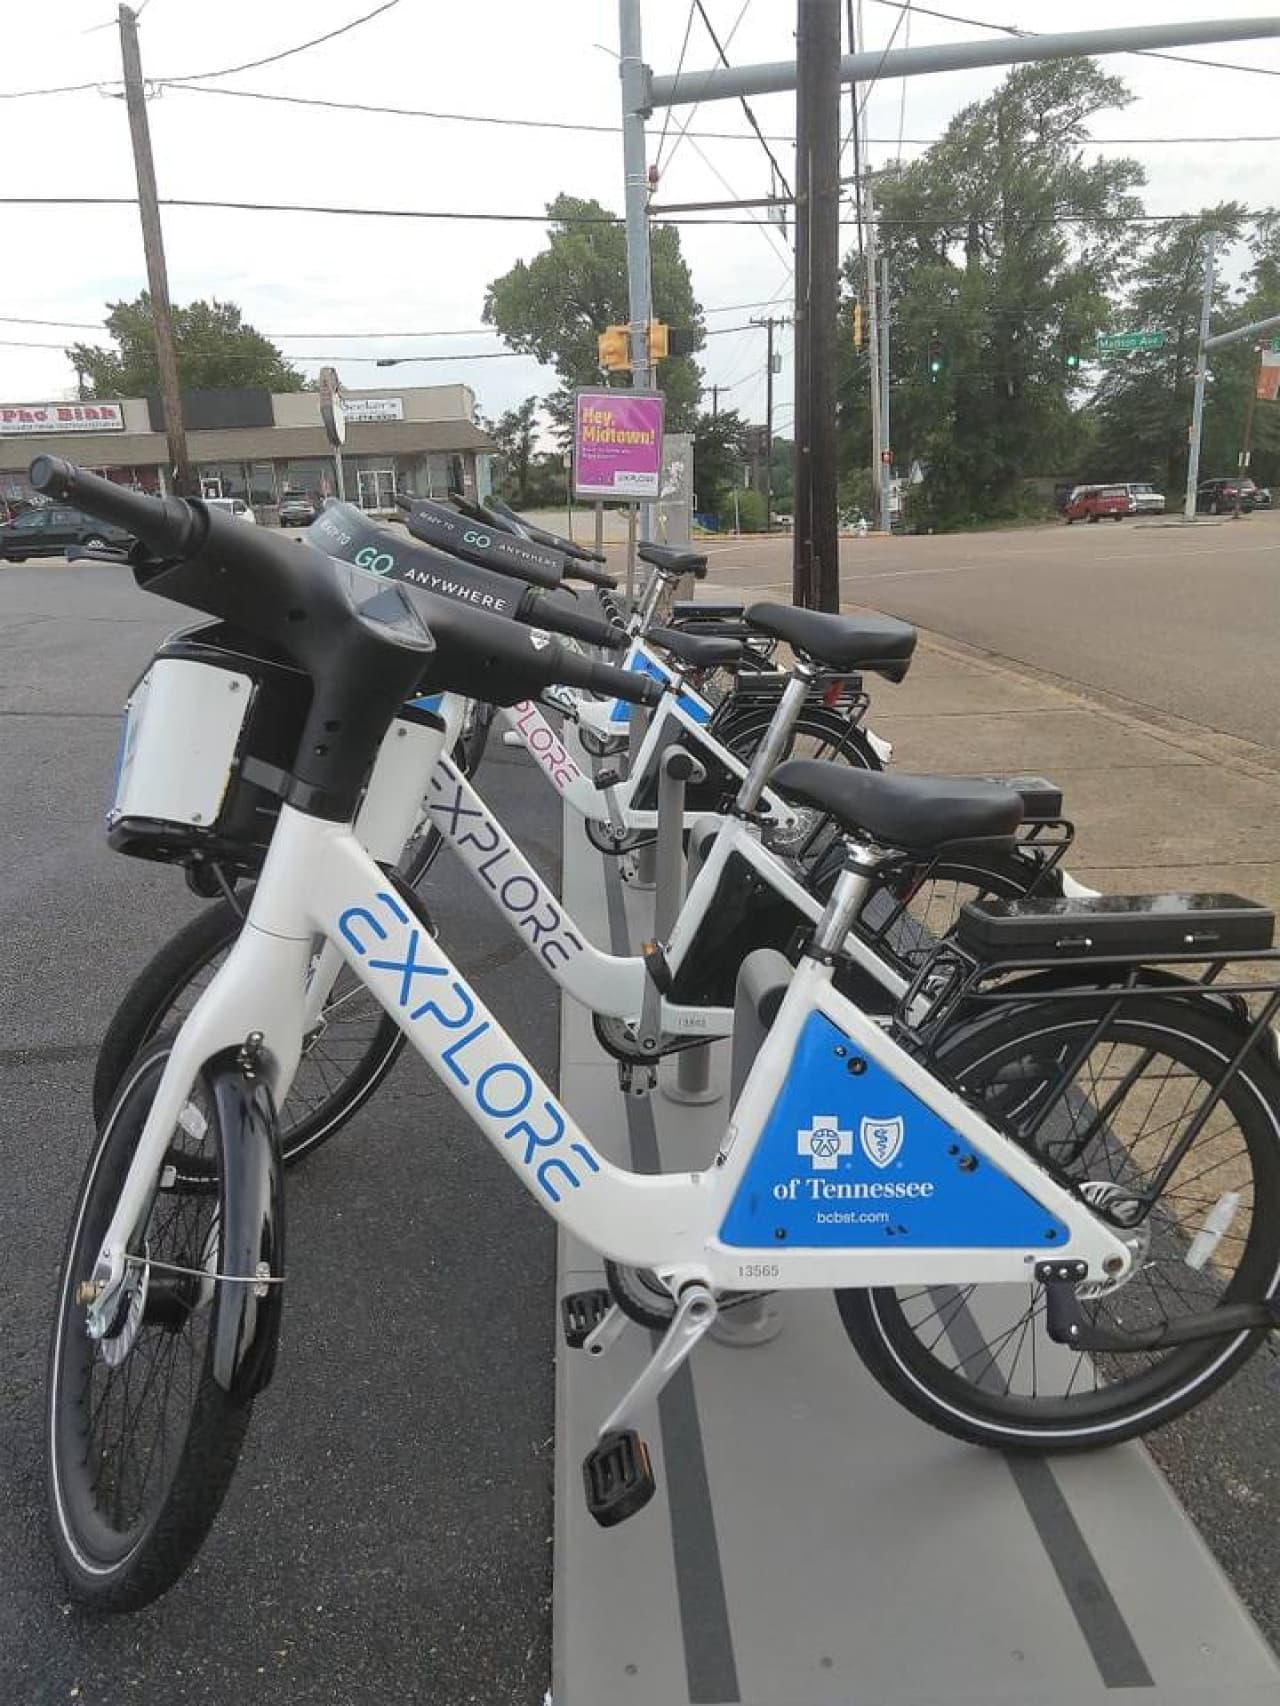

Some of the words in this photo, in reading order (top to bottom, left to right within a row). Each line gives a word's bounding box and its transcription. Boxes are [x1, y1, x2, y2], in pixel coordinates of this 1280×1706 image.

[582, 406, 615, 427] Hey,
[582, 426, 655, 445] Midtown!
[463, 530, 491, 548] GO
[355, 547, 394, 575] GO
[403, 567, 508, 611] ANYWHERE
[338, 892, 601, 1202] EXPLORE
[773, 1179, 800, 1200] of
[807, 1178, 935, 1200] Tennessee
[816, 1211, 890, 1225] bcbst.com
[739, 1265, 780, 1278] 13565
